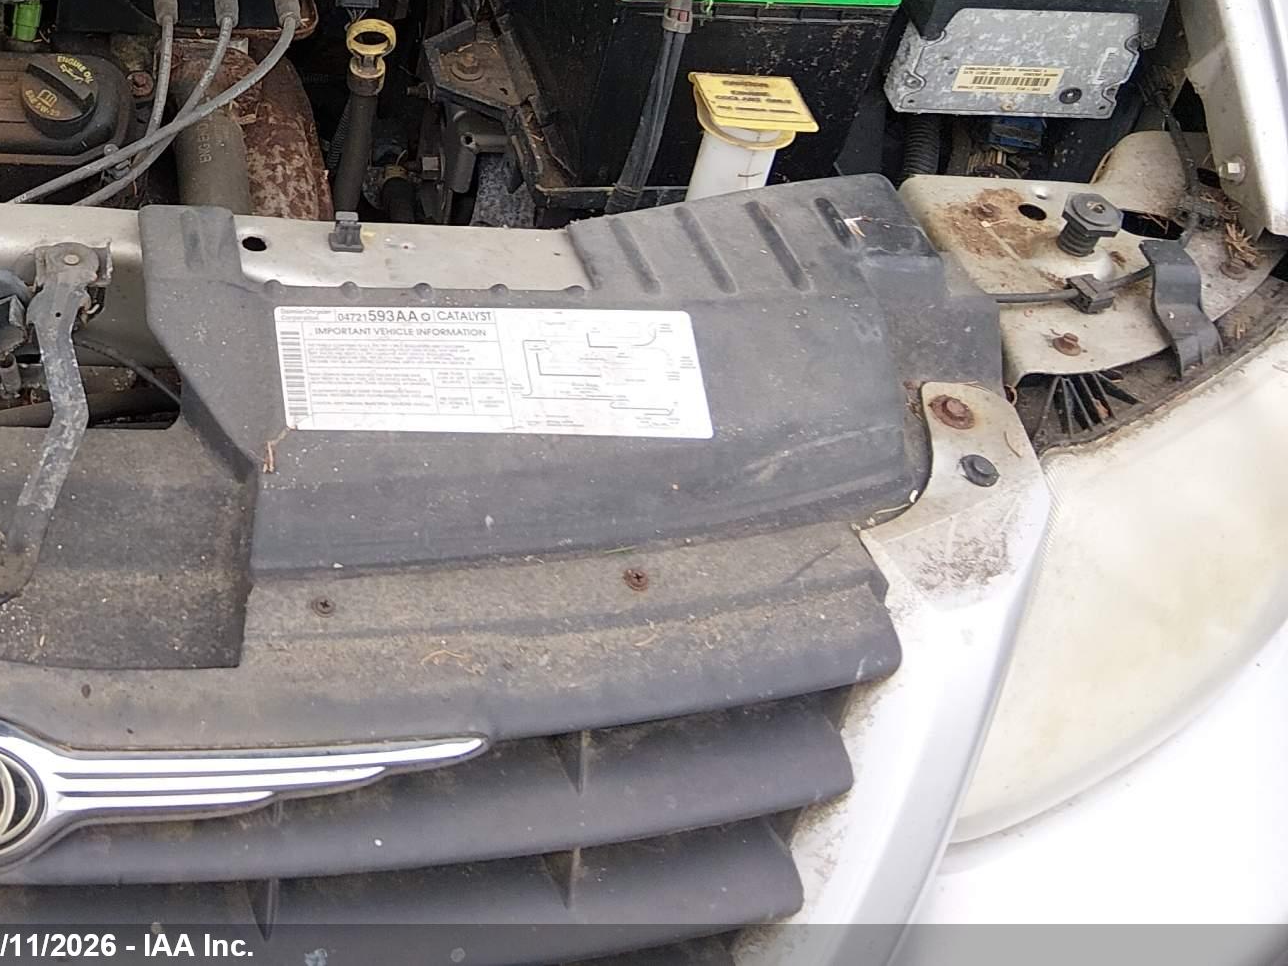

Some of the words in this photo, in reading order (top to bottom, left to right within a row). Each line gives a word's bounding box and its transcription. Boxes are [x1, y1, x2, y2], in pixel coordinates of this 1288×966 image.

[57, 55, 87, 72] ENGINE
[83, 70, 94, 84] OIL
[436, 310, 492, 322] CATALYST
[314, 327, 372, 336] IMPORTANT
[374, 327, 414, 336] VEHICLE
[416, 327, 487, 337] INFORMATION
